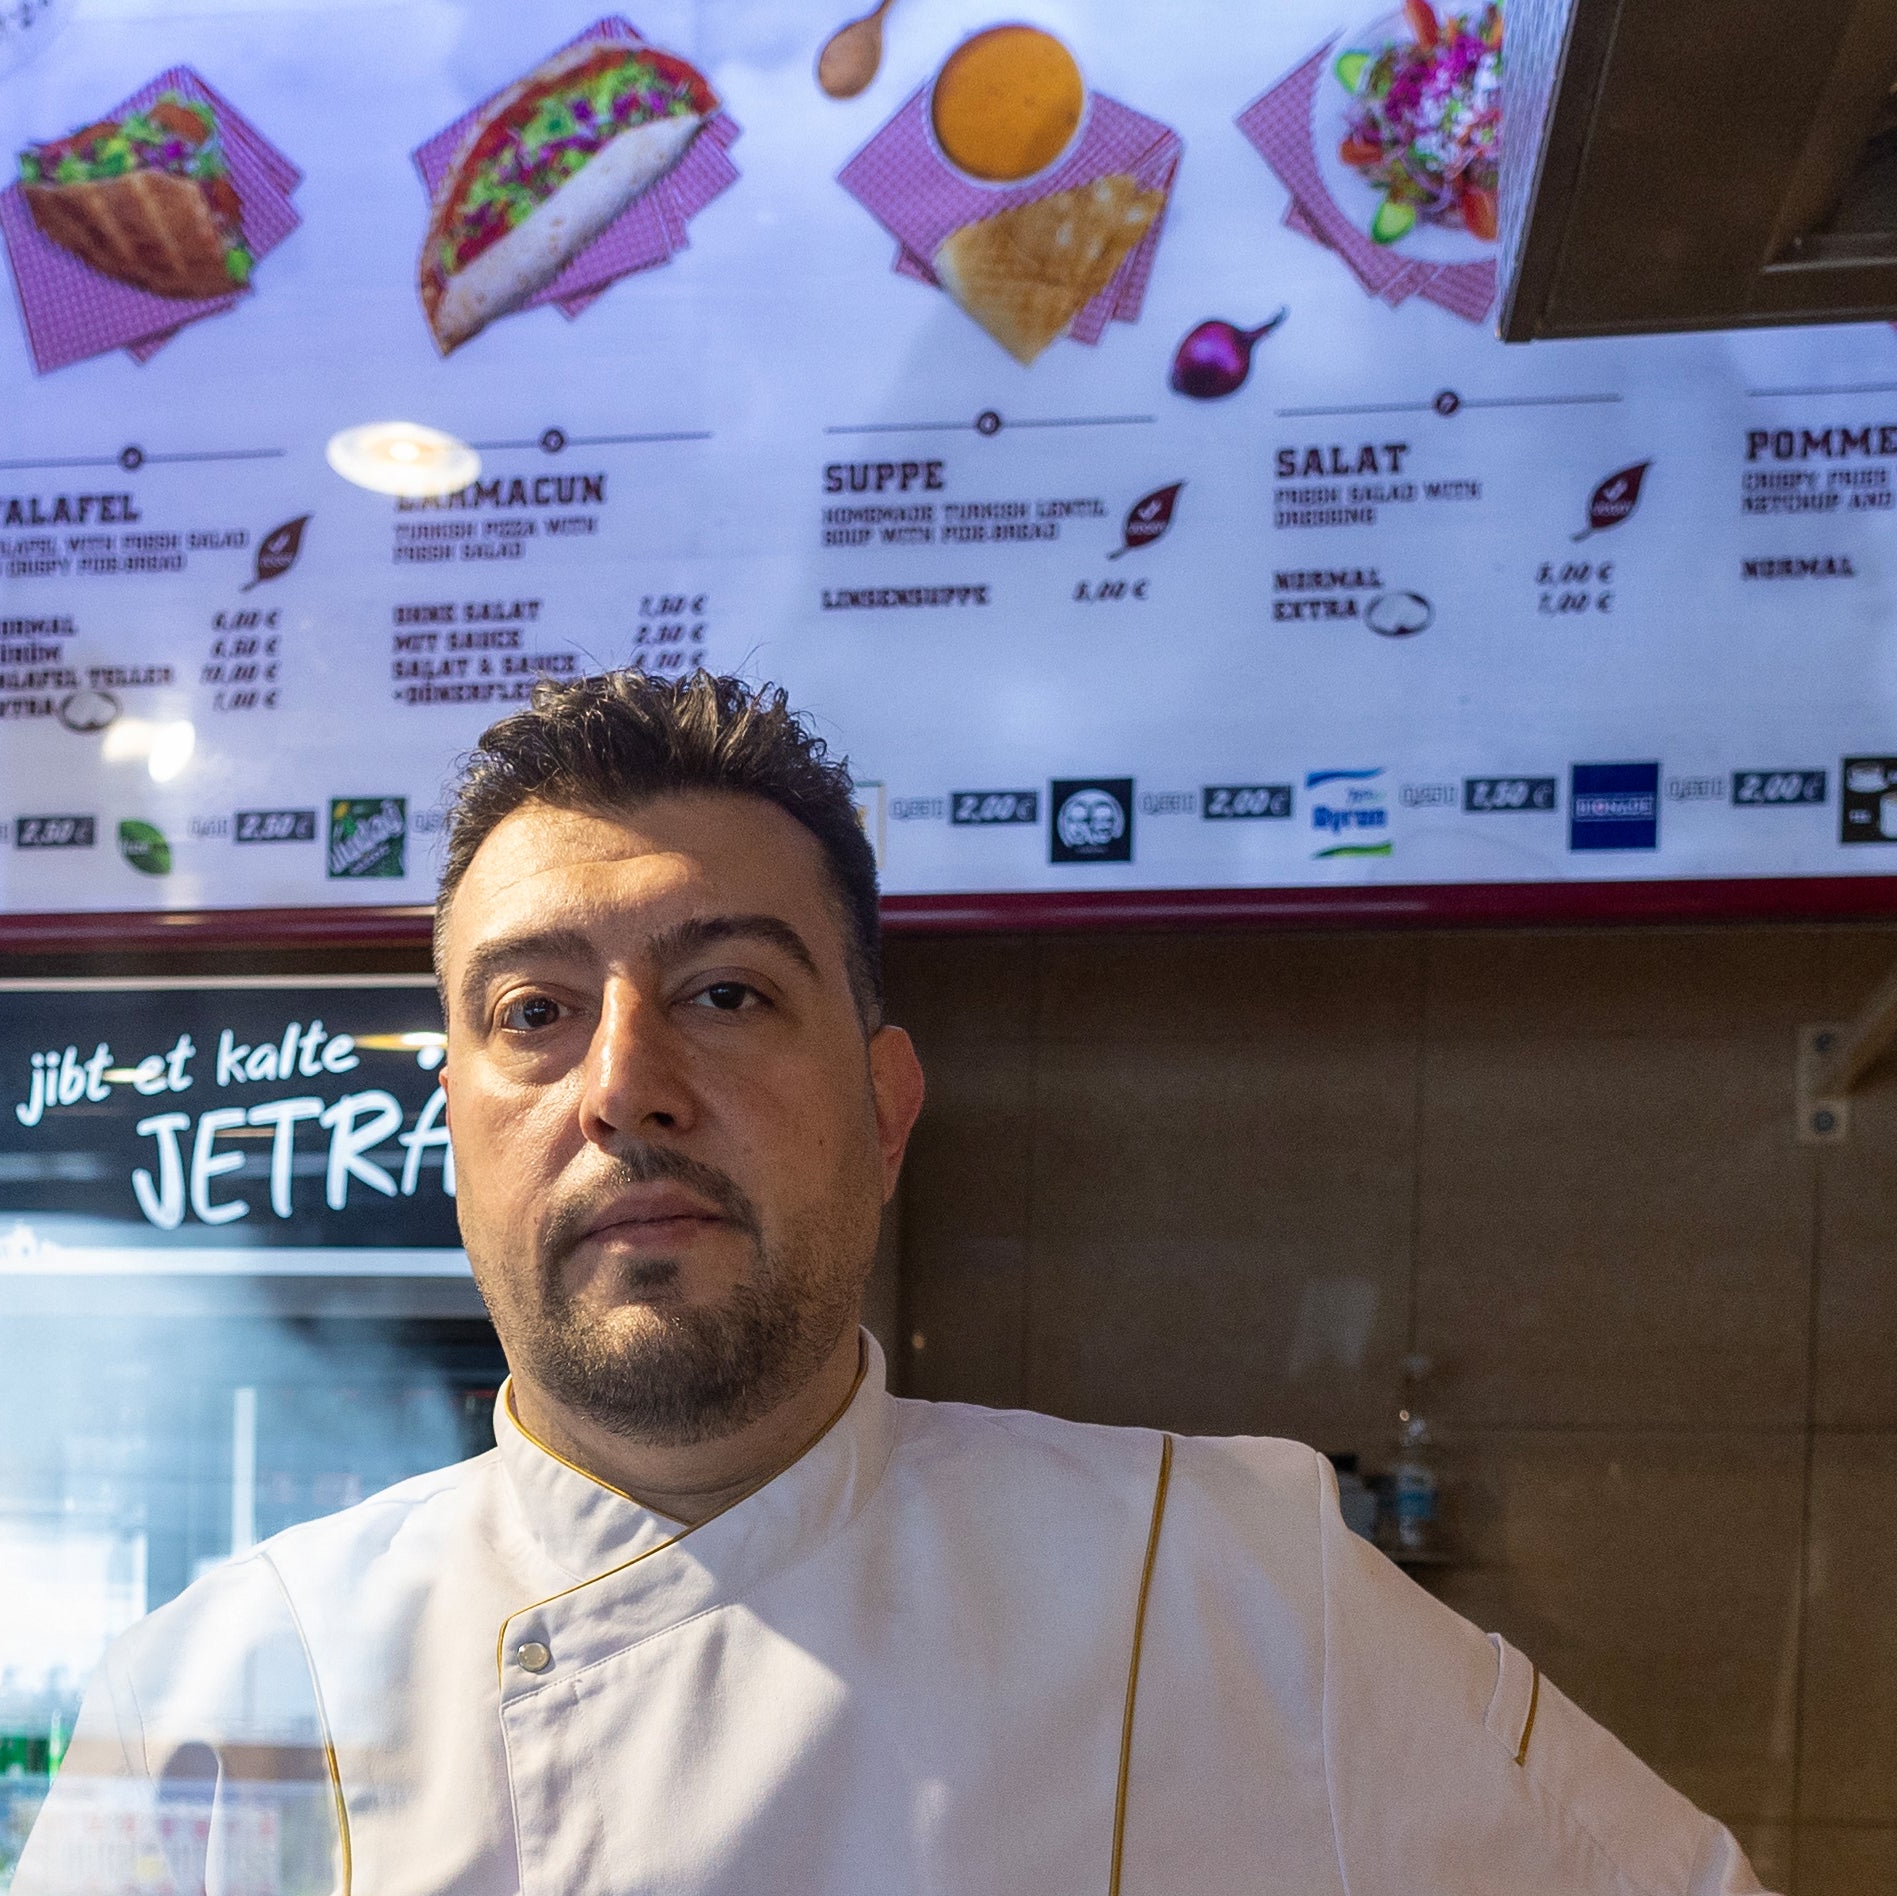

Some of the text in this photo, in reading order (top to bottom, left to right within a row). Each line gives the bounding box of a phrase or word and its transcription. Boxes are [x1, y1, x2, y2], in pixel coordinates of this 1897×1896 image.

[1276, 442, 1409, 479] SALAT
[824, 460, 945, 494] SUPPE
[880, 525, 933, 544] WITH
[1274, 568, 1384, 591] NORMAL
[1741, 556, 1855, 580] NORMAL
[823, 585, 990, 610] LINSENSUPPE
[1274, 598, 1359, 621] EXTRA
[395, 599, 542, 625] OHNE SALAT
[395, 628, 522, 653] MIT SAUCE
[87, 664, 172, 687] TELLER
[393, 655, 468, 679] SALAT
[502, 653, 578, 676] SAUCE
[15, 1043, 113, 1128] jibt
[133, 1033, 196, 1098] et
[217, 1018, 361, 1088] kalte
